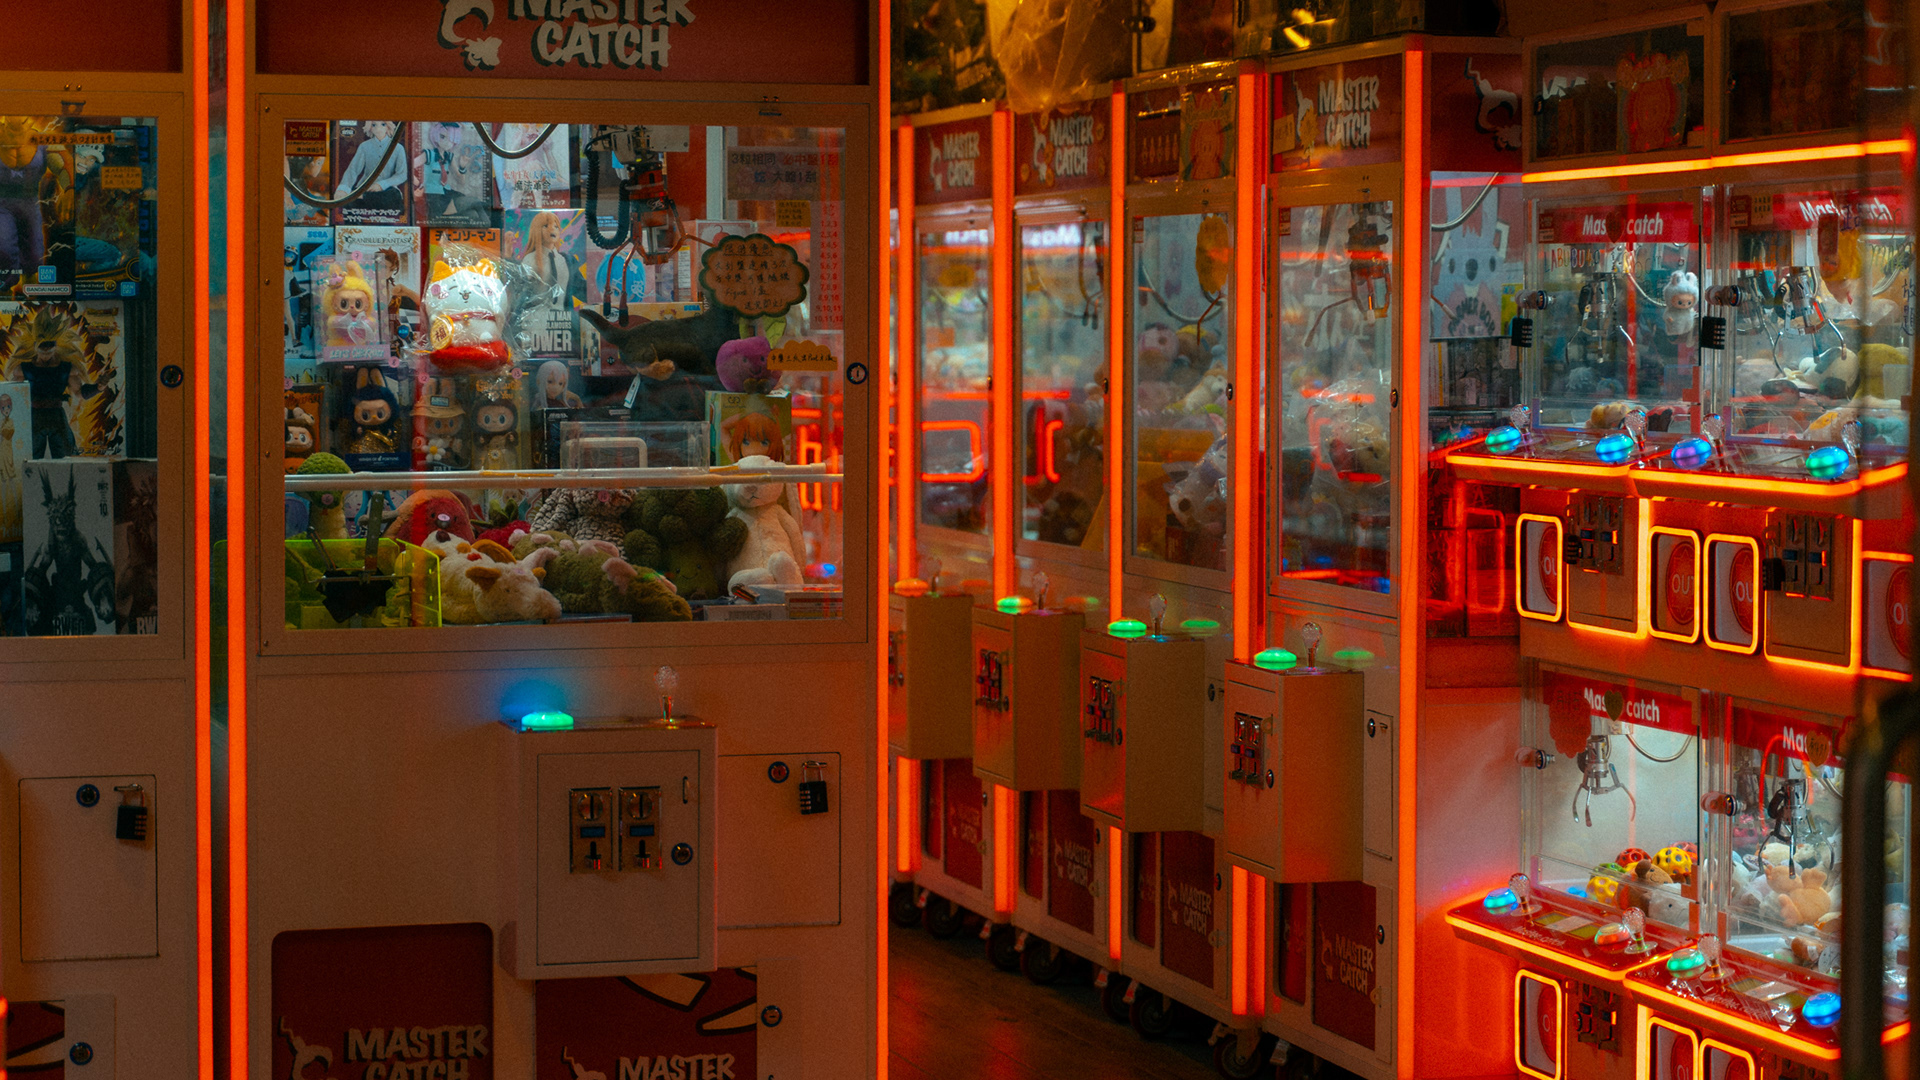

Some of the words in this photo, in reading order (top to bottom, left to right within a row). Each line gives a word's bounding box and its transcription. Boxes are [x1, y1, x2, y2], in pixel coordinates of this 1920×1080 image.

[533, 20, 671, 68] CATCH
[1318, 74, 1381, 116] MASTER
[1049, 115, 1096, 147] MASTER
[1325, 111, 1371, 149] CATCH
[943, 131, 981, 161] MASTER
[947, 159, 976, 188] CATCH
[1054, 145, 1089, 177] CATCH
[307, 231, 328, 239] SEGA
[1582, 214, 1608, 236] Mas
[1626, 211, 1663, 237] catch
[346, 235, 381, 244] GRANBLUE
[531, 330, 572, 352] OWER
[1543, 559, 1558, 576] OU
[1735, 580, 1755, 601] OU
[1892, 603, 1912, 625] OU
[1583, 687, 1608, 713] Mas
[1626, 698, 1661, 723] catch
[1063, 840, 1093, 868] MASTER
[1066, 862, 1089, 887] CATCH
[1179, 882, 1213, 916] MASTER
[1183, 908, 1208, 937] CATCH
[1335, 933, 1375, 973] MASTER
[1339, 962, 1370, 997] CATCH
[346, 1024, 489, 1062] MASTER
[618, 1053, 737, 1080] MASTER
